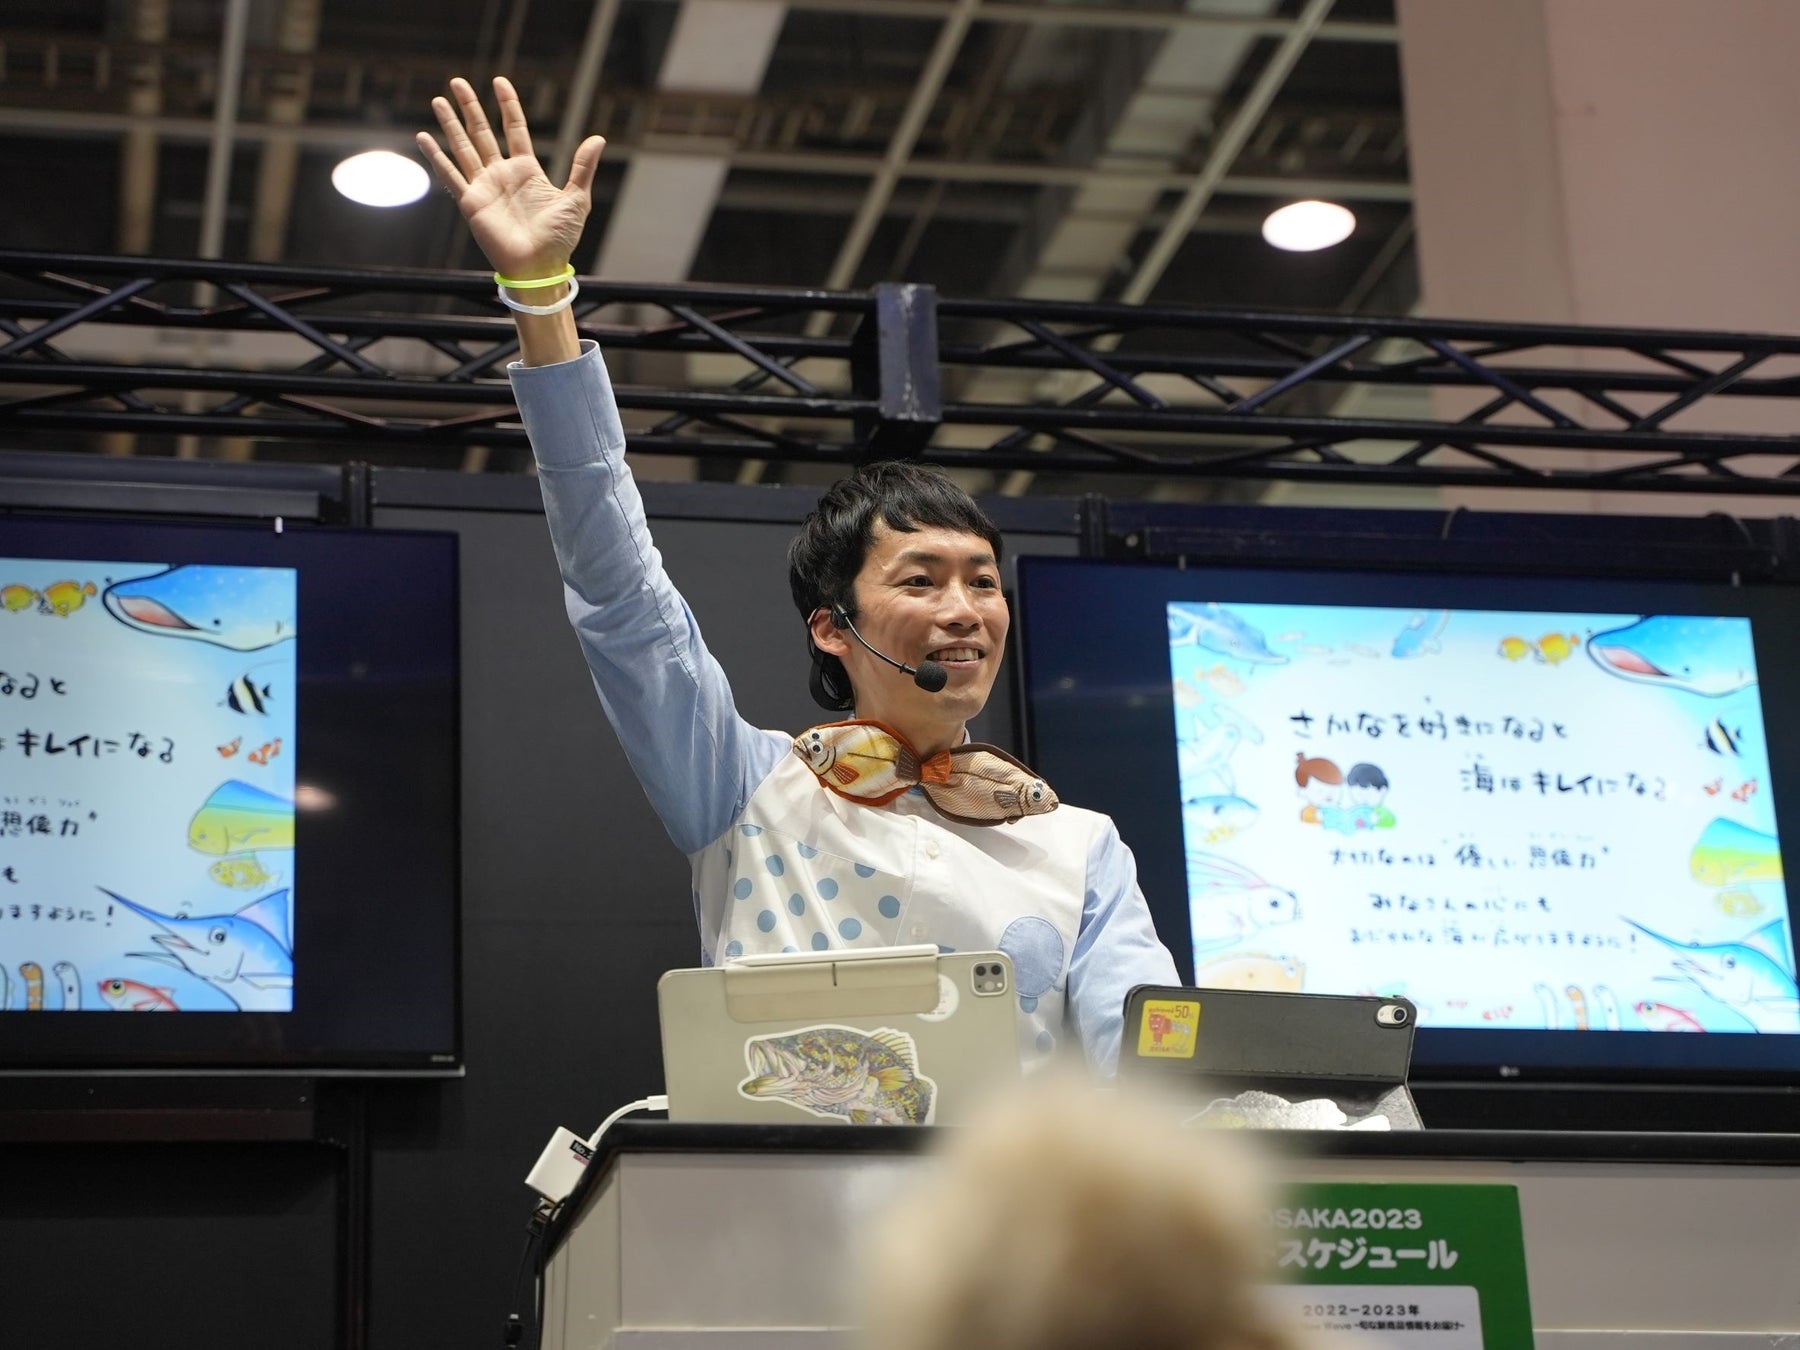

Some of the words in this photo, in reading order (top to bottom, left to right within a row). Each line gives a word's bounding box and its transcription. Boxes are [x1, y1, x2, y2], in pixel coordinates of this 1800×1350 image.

[1289, 709, 1568, 742] さかなを好きになると
[1270, 1236, 1459, 1271] スケジュール
